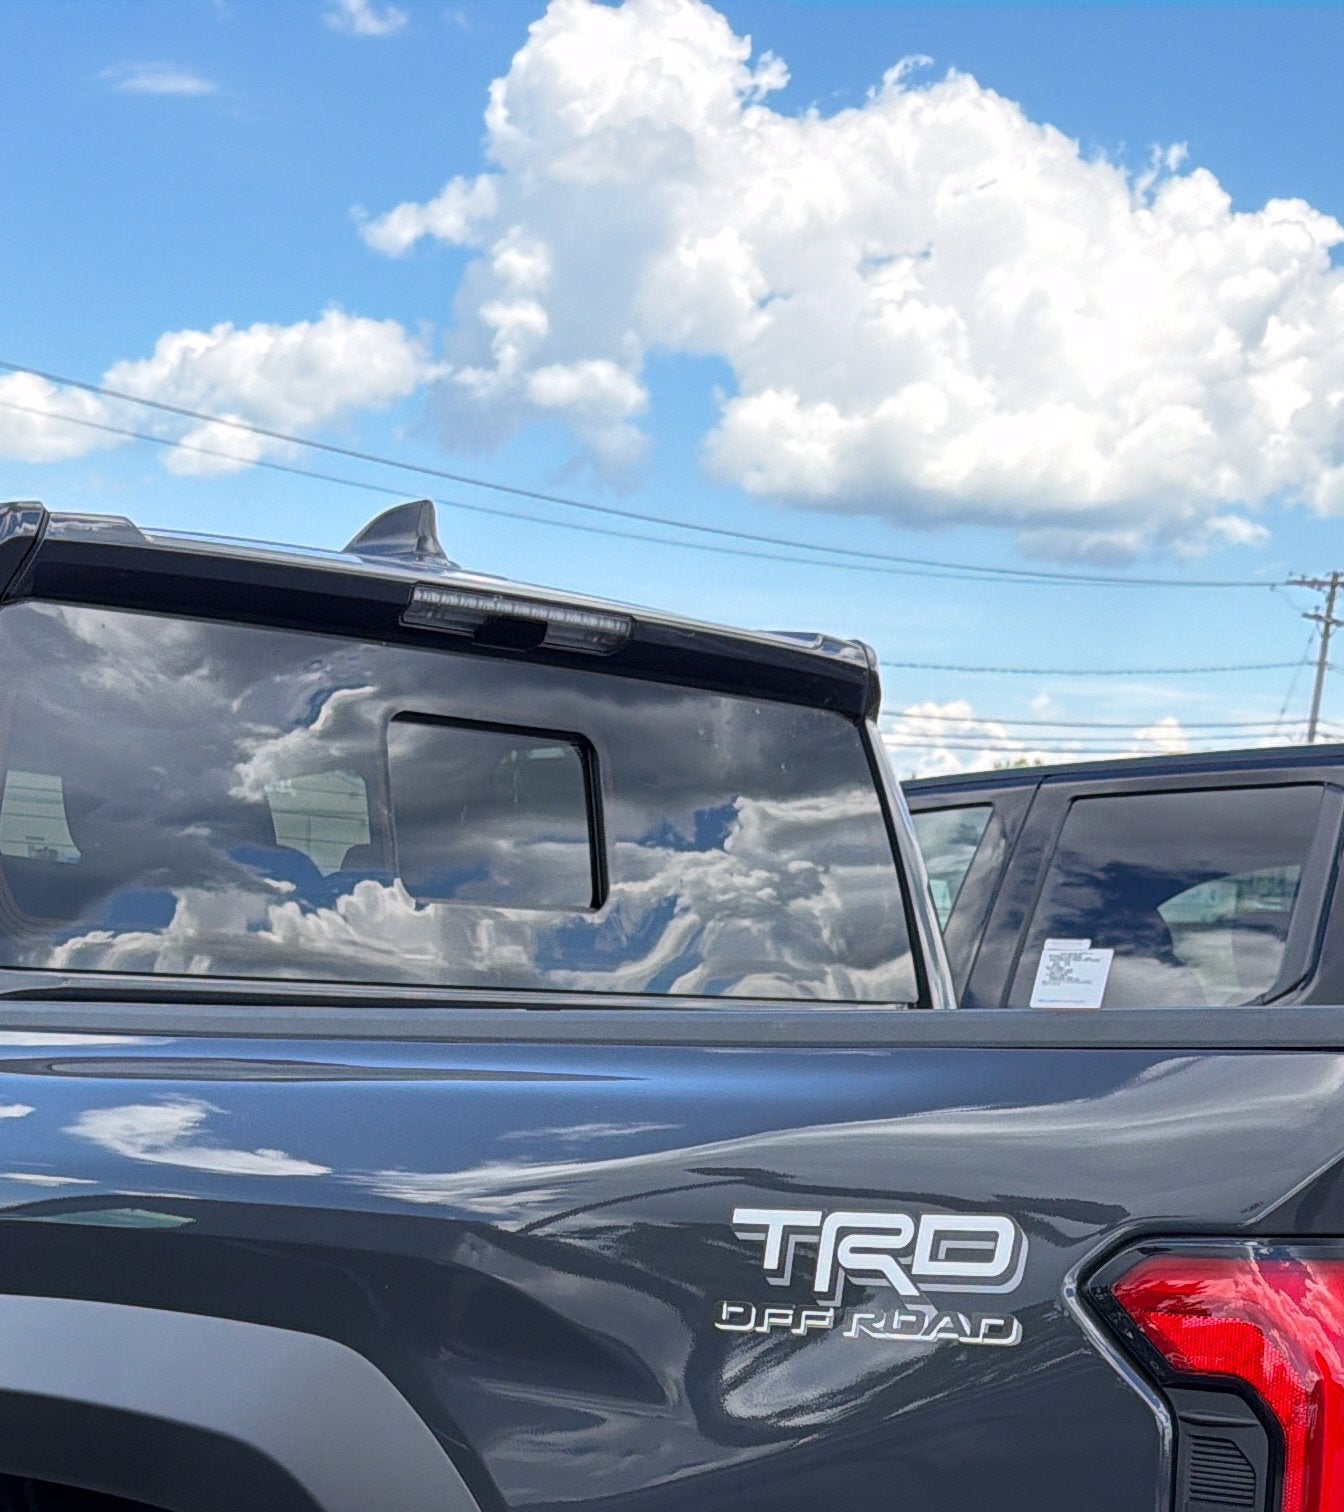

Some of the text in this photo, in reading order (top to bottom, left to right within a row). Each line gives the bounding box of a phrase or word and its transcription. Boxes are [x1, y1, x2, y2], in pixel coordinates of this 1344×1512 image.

[731, 1207, 1030, 1307] TRD
[714, 1300, 1024, 1347] OFF ROAD
